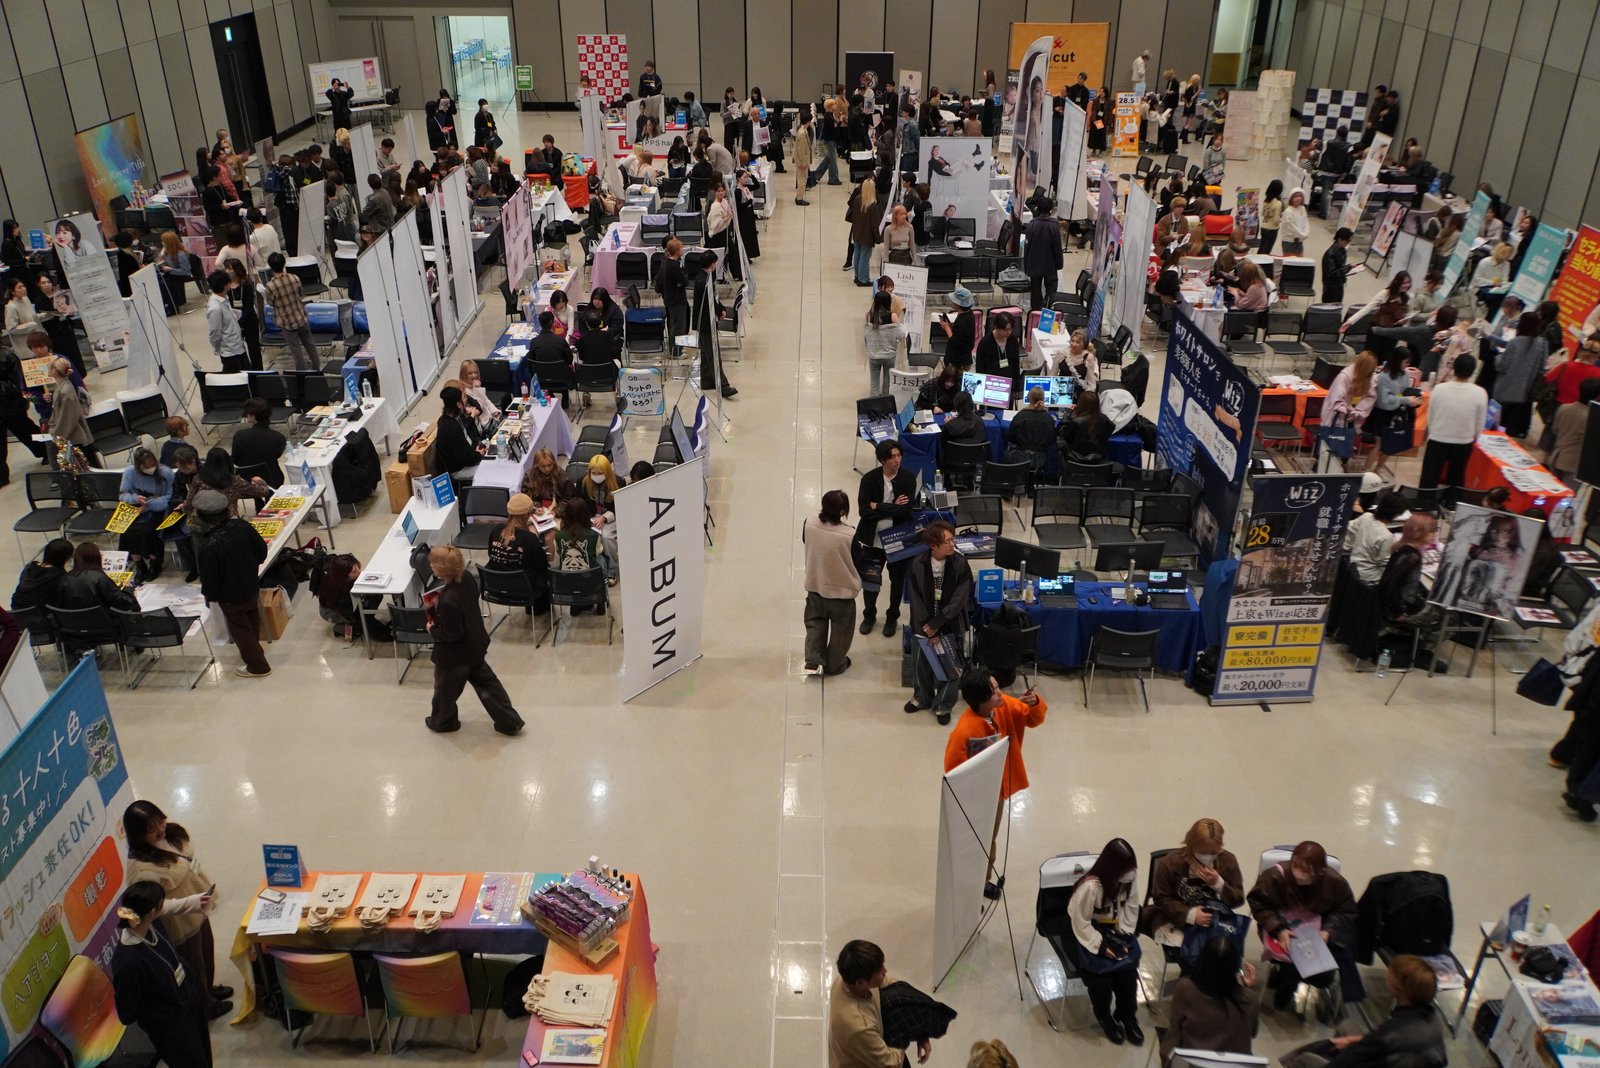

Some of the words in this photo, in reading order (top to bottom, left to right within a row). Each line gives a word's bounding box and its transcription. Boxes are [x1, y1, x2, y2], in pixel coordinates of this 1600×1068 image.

[1050, 51, 1075, 63] cut
[661, 138, 673, 146] hai
[896, 272, 915, 281] Lish
[1175, 320, 1221, 381] ホワイトサロンで
[622, 389, 661, 399] スペシャリストに
[628, 384, 652, 392] カットの
[1290, 486, 1319, 500] Wiz
[1325, 482, 1352, 560] ホワイトサロンに
[648, 496, 676, 670] ALBUM
[1234, 599, 1267, 608] あなたの
[1231, 607, 1319, 620] 上京をWizが応援
[1234, 630, 1268, 641] 寮完備
[1283, 626, 1319, 635] 住宅手当
[1229, 655, 1312, 666] 最大80,000円支給
[1222, 679, 1307, 691] 最大20,000円支給
[2, 710, 83, 826] る十人十色
[83, 867, 108, 908] 撮影
[13, 941, 60, 1010] ヘアショー
